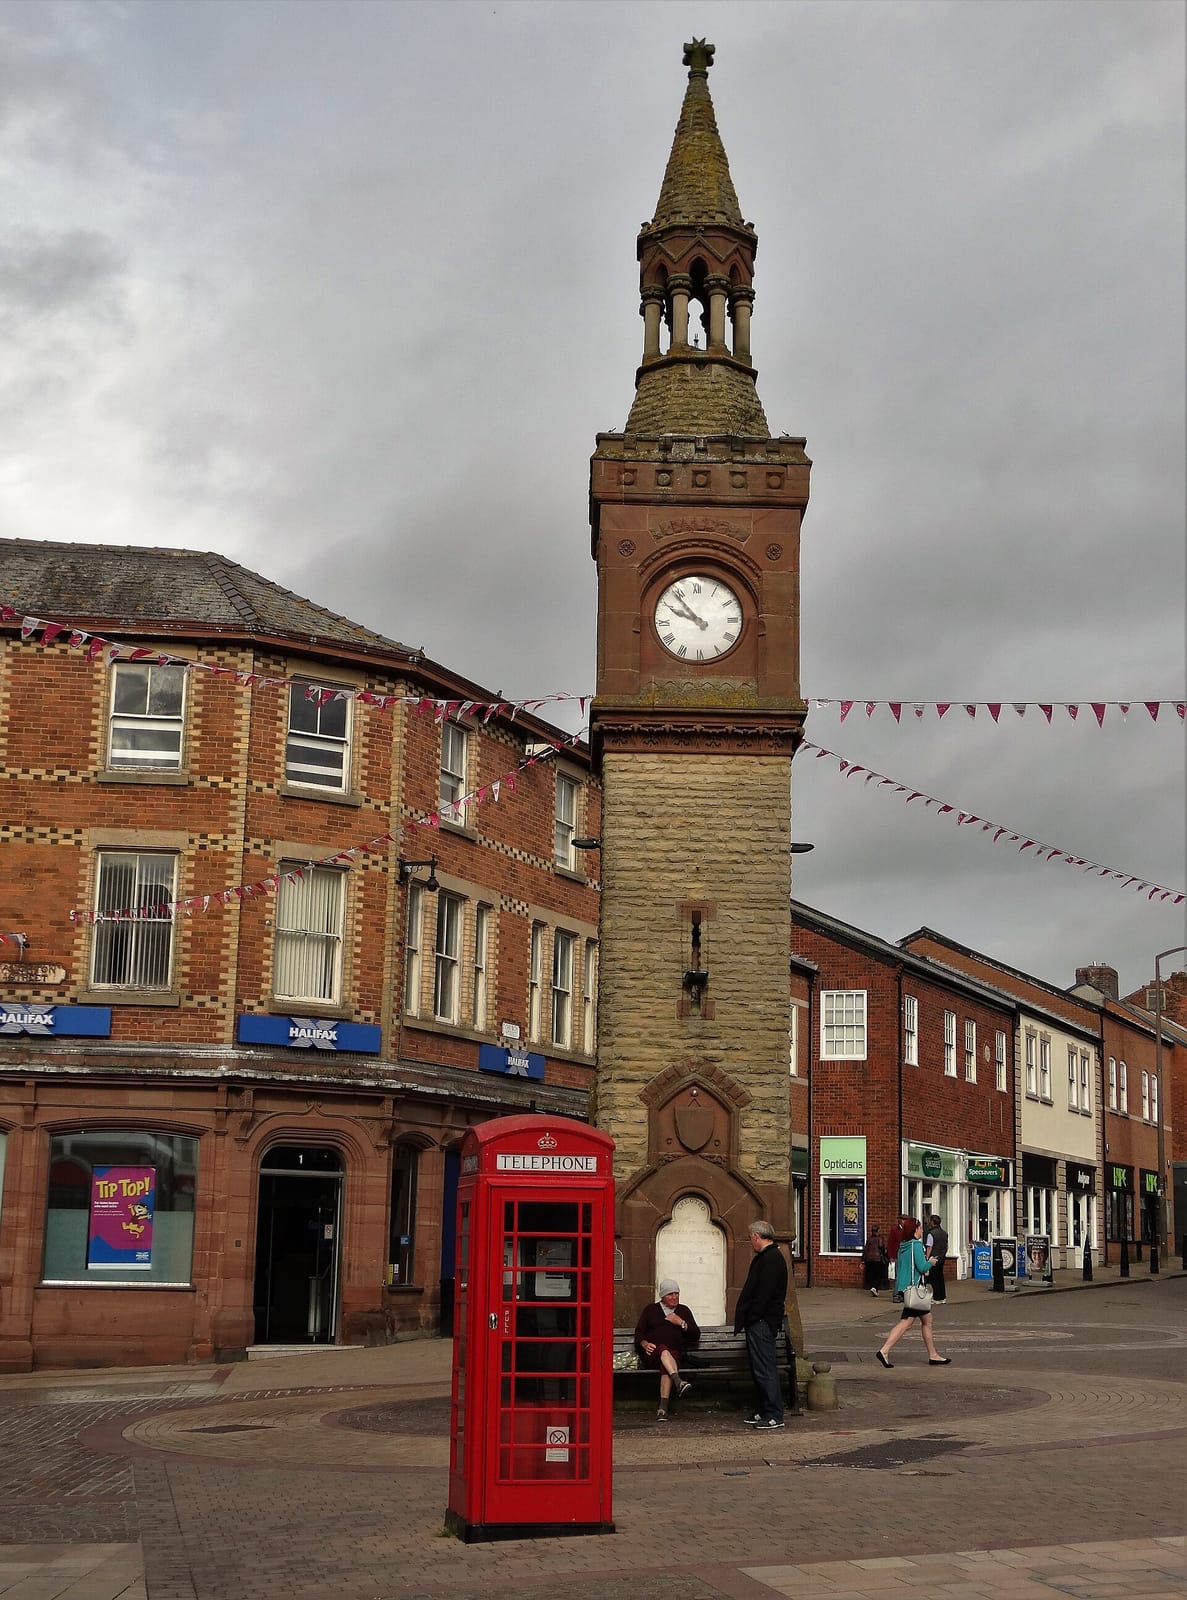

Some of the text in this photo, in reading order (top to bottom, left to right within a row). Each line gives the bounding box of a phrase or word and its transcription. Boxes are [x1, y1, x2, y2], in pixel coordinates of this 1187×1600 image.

[693, 583, 701, 594] XII
[289, 1027, 338, 1041] HALIFAX
[507, 1056, 529, 1069] HALIFAX
[500, 1155, 593, 1170] TELEPHONE
[823, 1159, 863, 1171] Opticians
[968, 1168, 998, 1177] Specsavers
